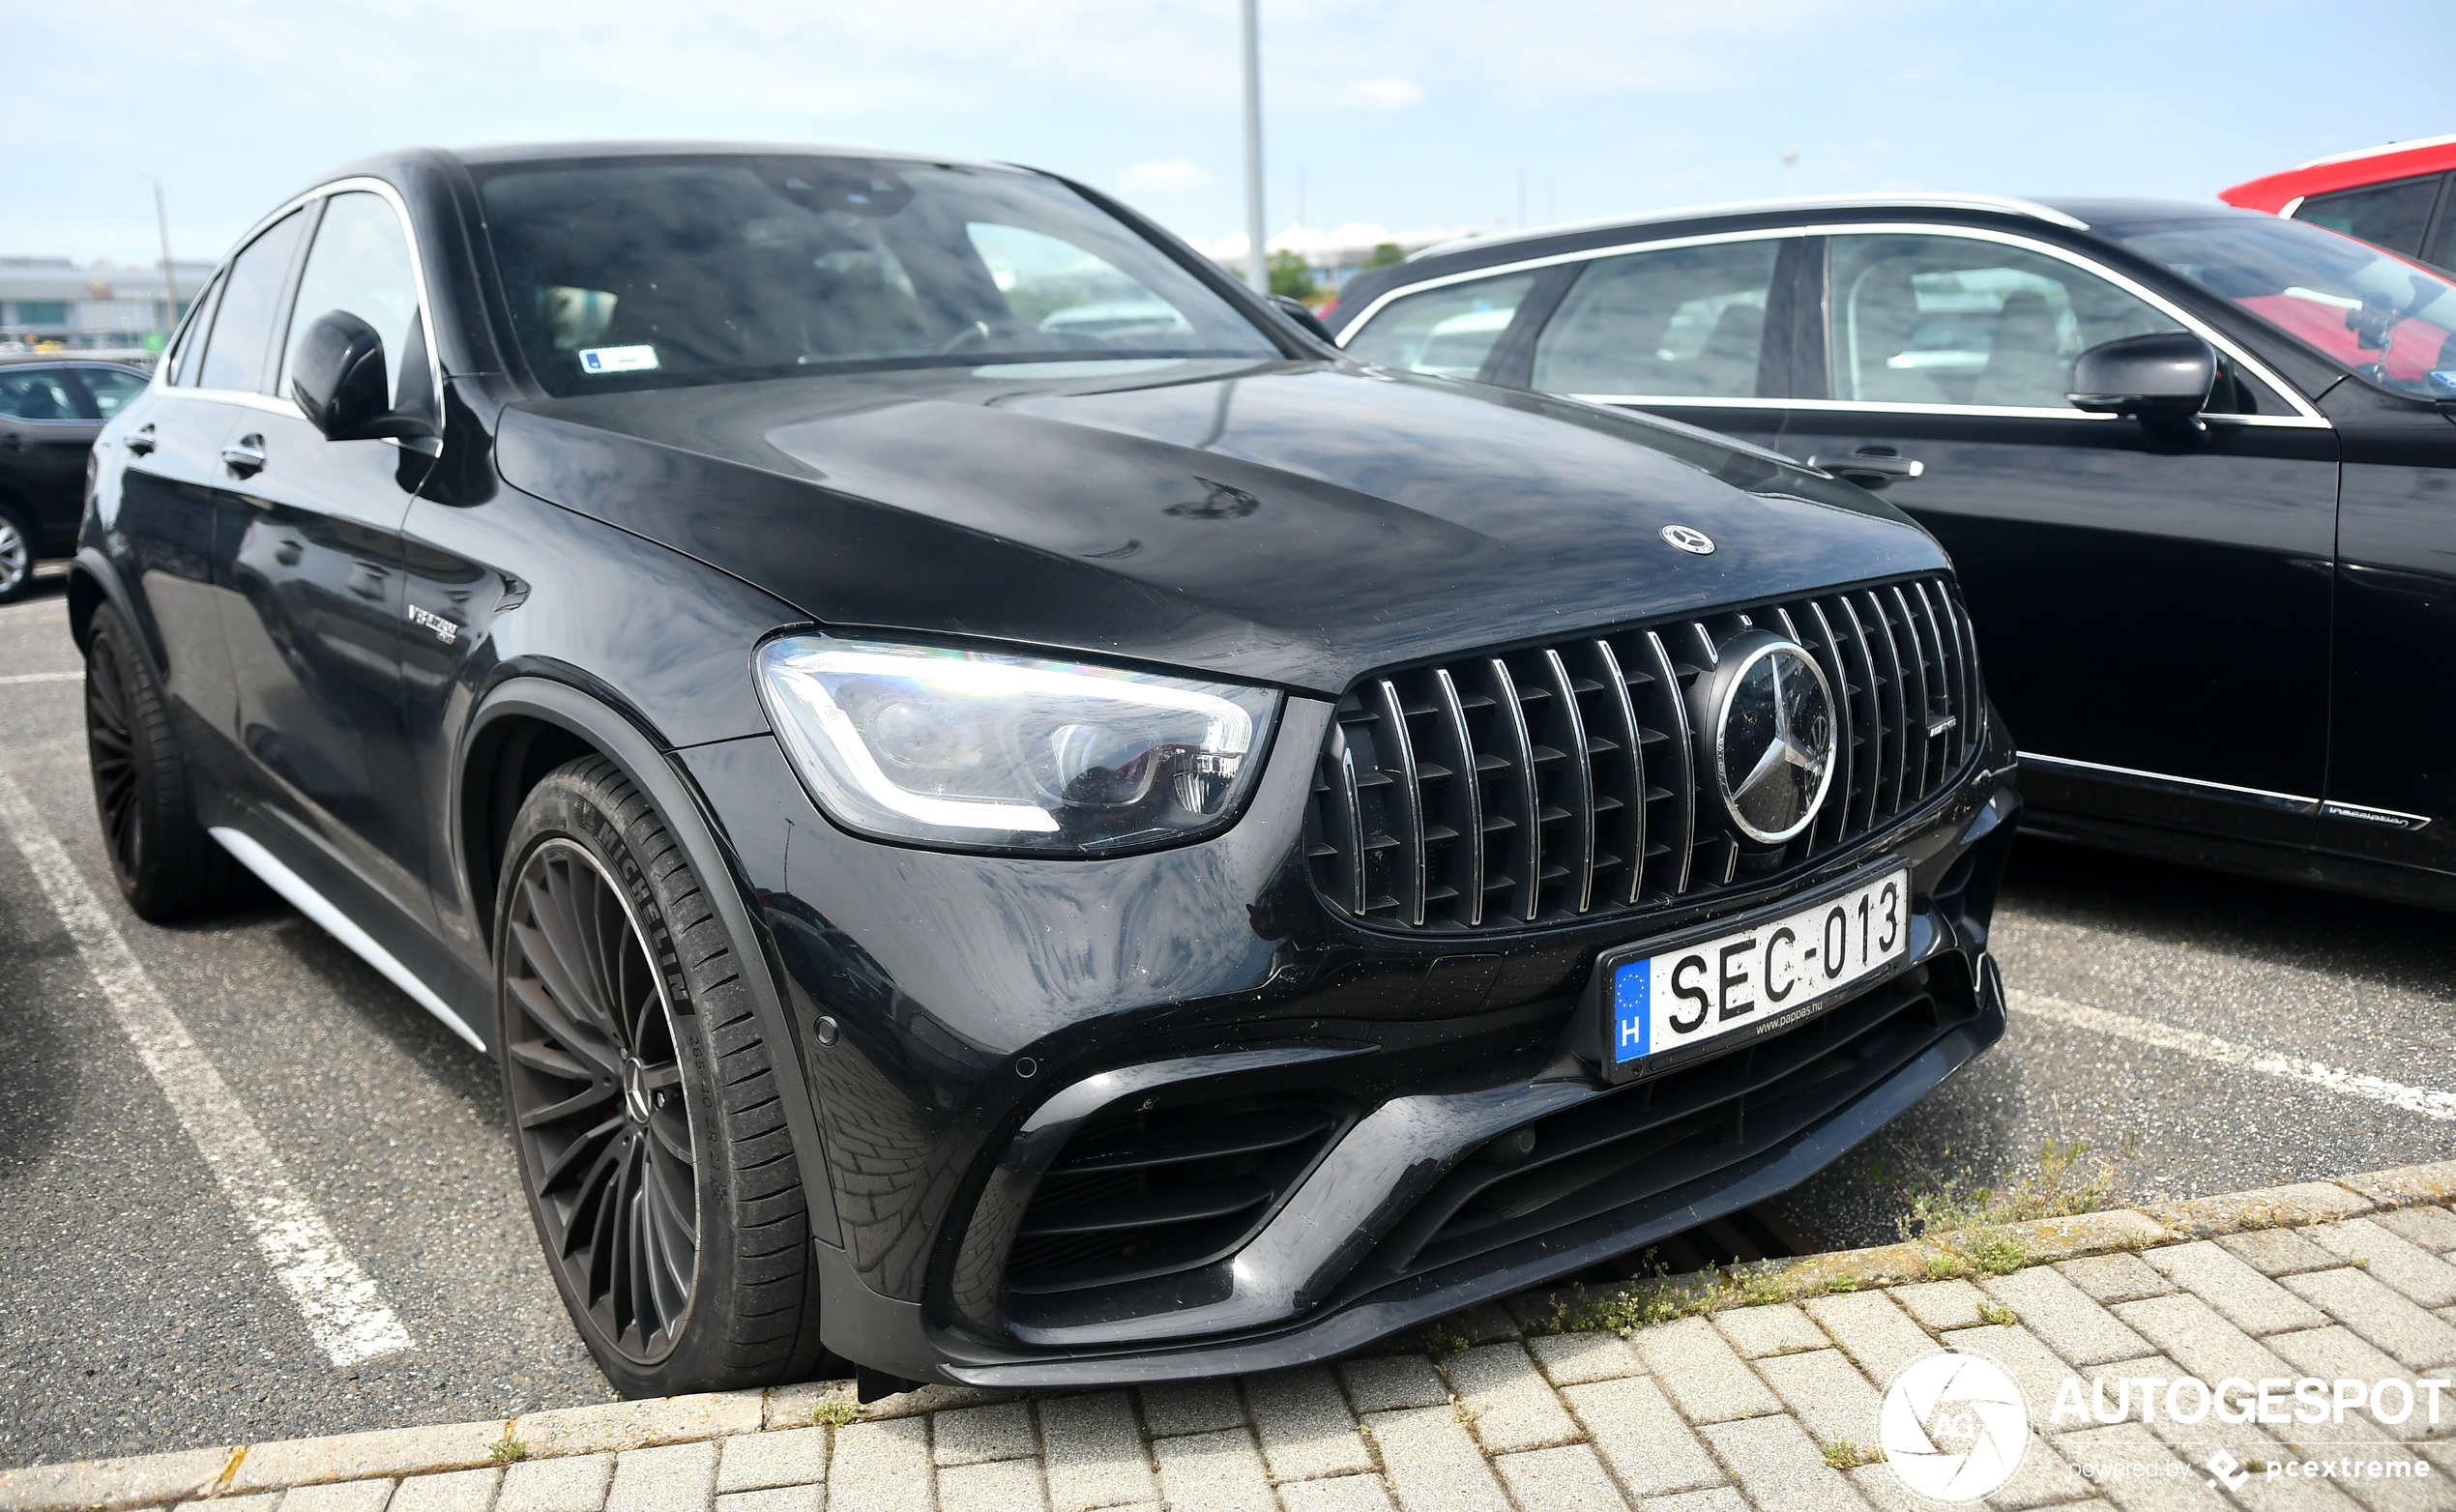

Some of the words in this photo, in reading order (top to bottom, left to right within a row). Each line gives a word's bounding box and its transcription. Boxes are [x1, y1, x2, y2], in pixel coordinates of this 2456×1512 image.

[598, 821, 689, 1002] MICHELIN
[1668, 881, 1898, 1034] SEC-013
[1621, 1017, 1640, 1047] H
[1756, 1001, 1823, 1035] www.pappas.hu
